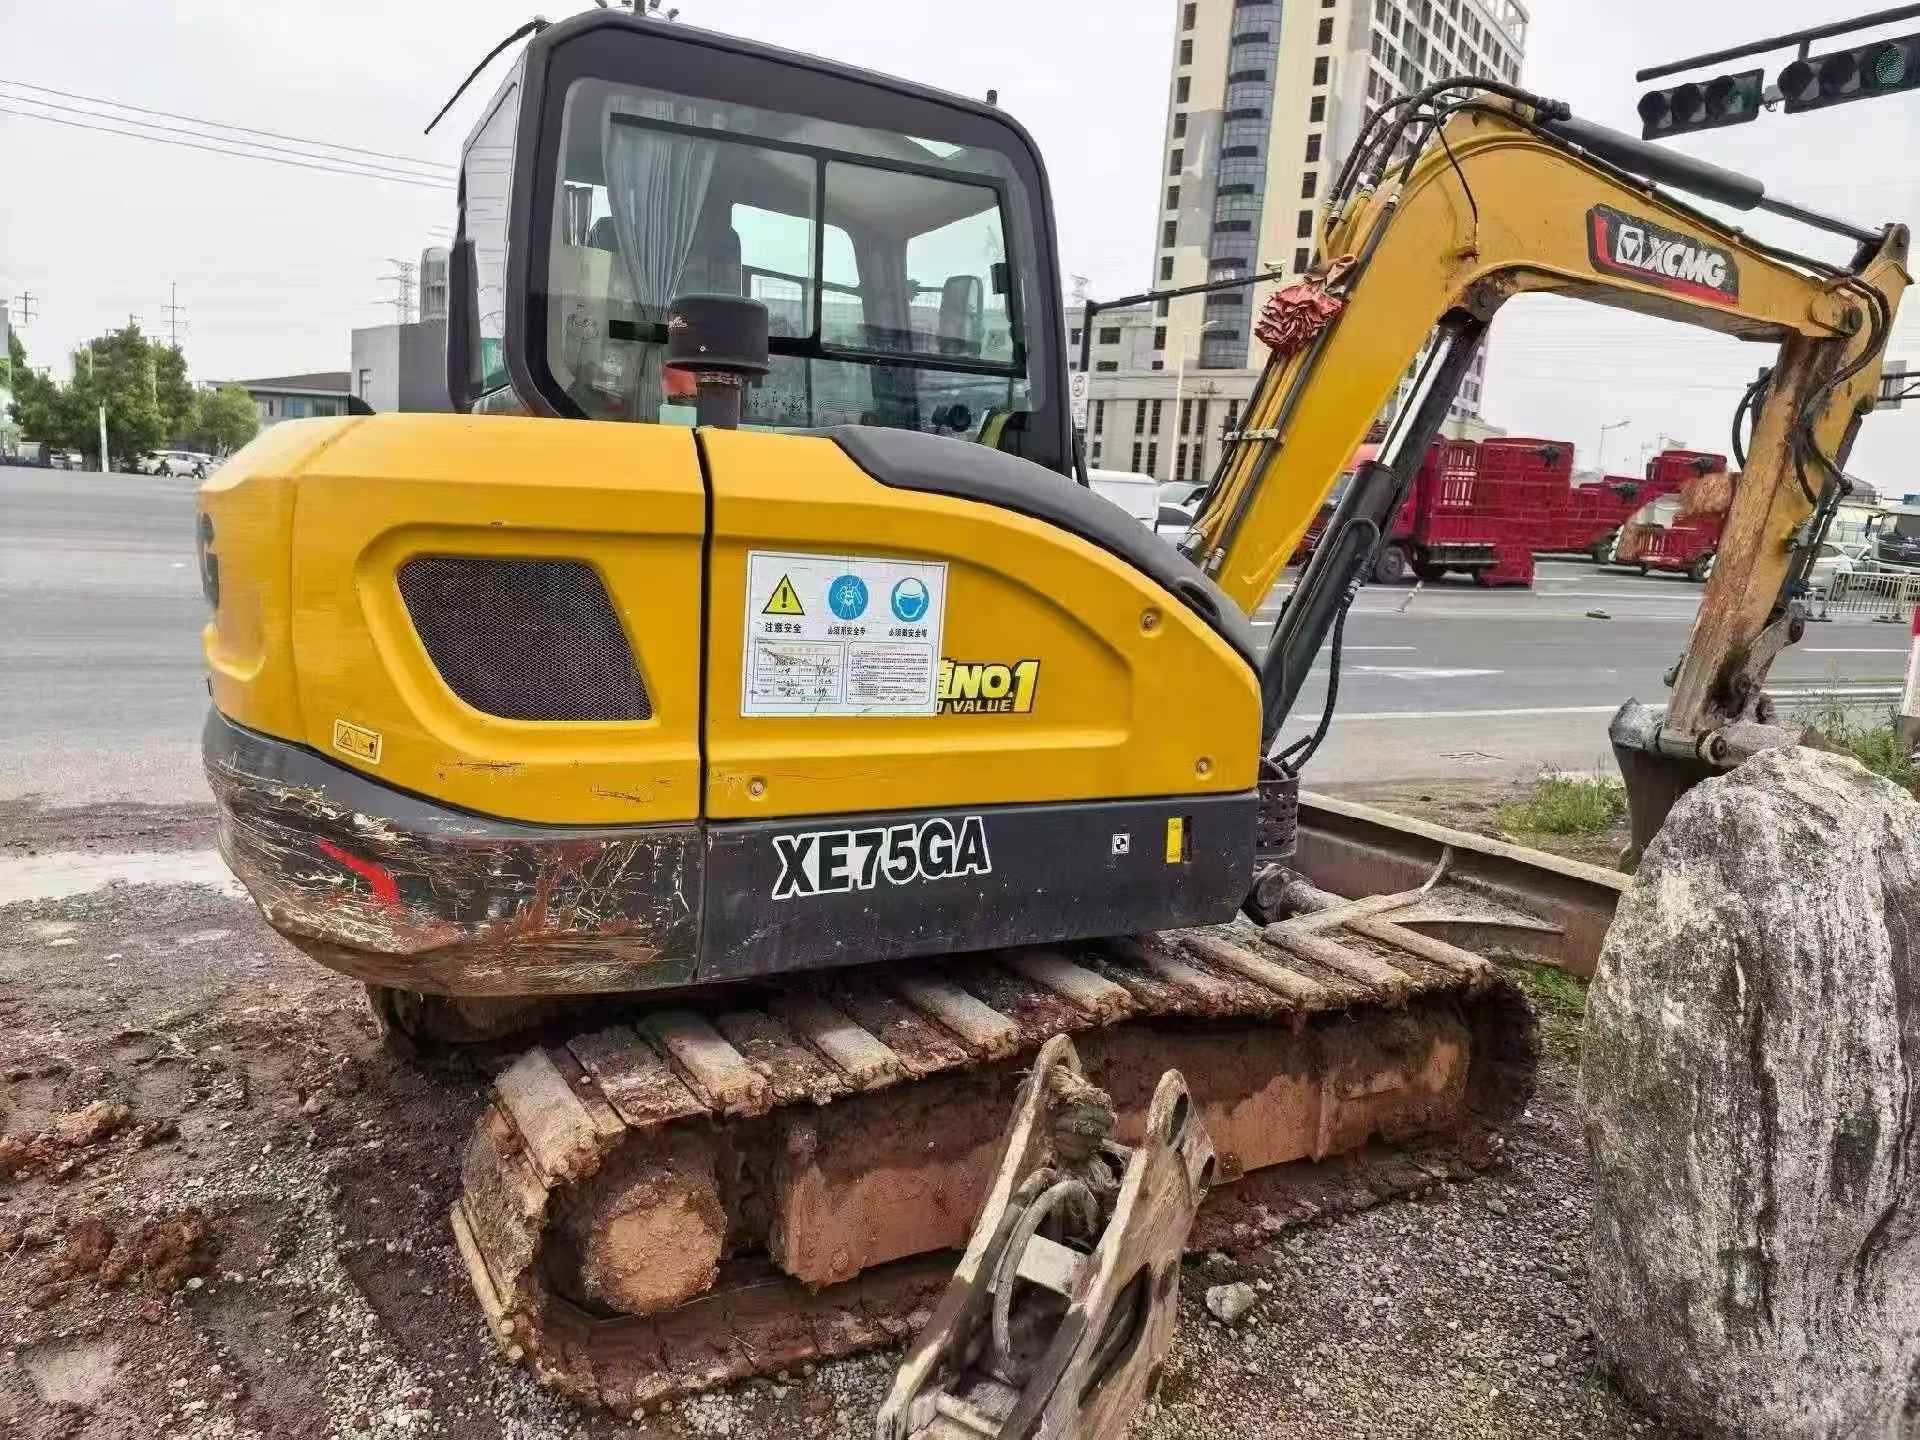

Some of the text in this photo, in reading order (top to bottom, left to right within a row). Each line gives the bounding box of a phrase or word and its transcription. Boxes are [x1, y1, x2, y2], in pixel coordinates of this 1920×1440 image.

[1641, 238, 1726, 289] XCMG
[765, 622, 802, 634] 注意安全
[952, 699, 1011, 713] VALUE
[772, 816, 992, 900] XE75GA
